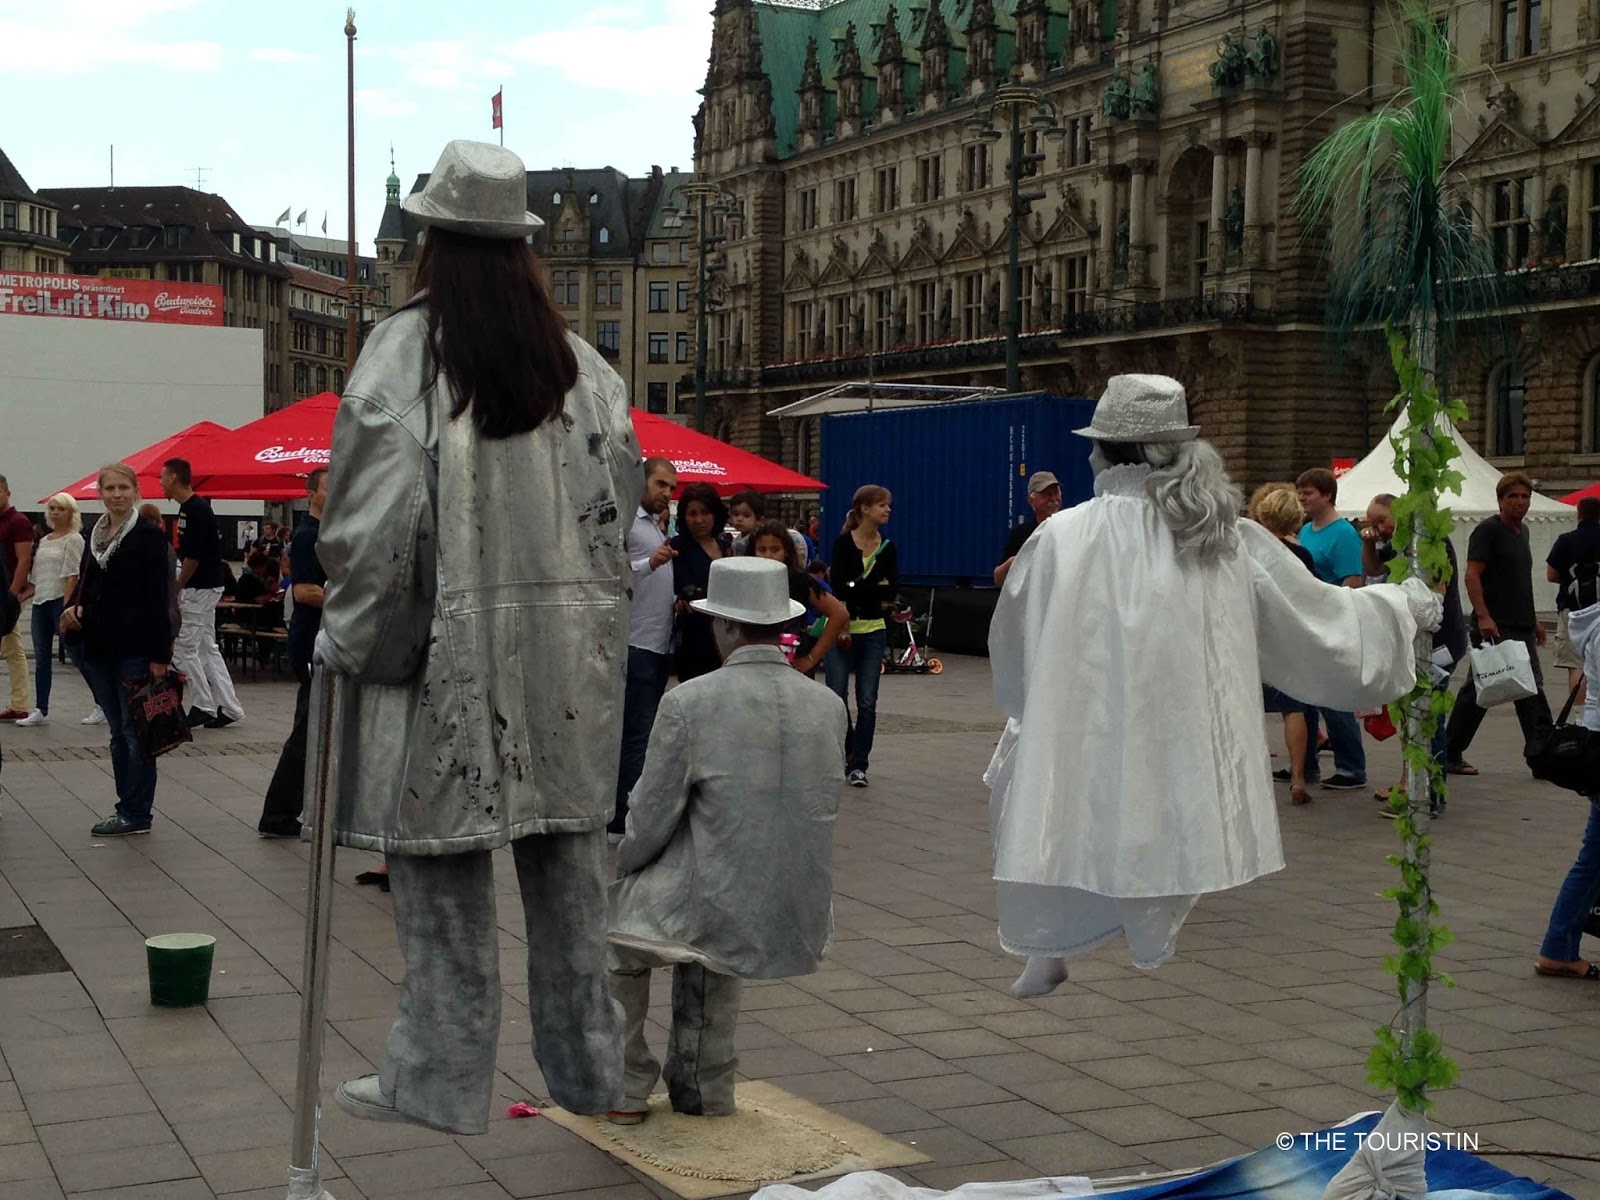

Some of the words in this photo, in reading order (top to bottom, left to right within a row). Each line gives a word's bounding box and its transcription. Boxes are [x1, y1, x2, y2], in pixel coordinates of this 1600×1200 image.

[0, 274, 80, 290] METROPOLIS
[0, 288, 93, 317] FreiLuft
[97, 294, 150, 320] Kino
[154, 291, 216, 312] Budweiser
[254, 445, 332, 464] Budwe
